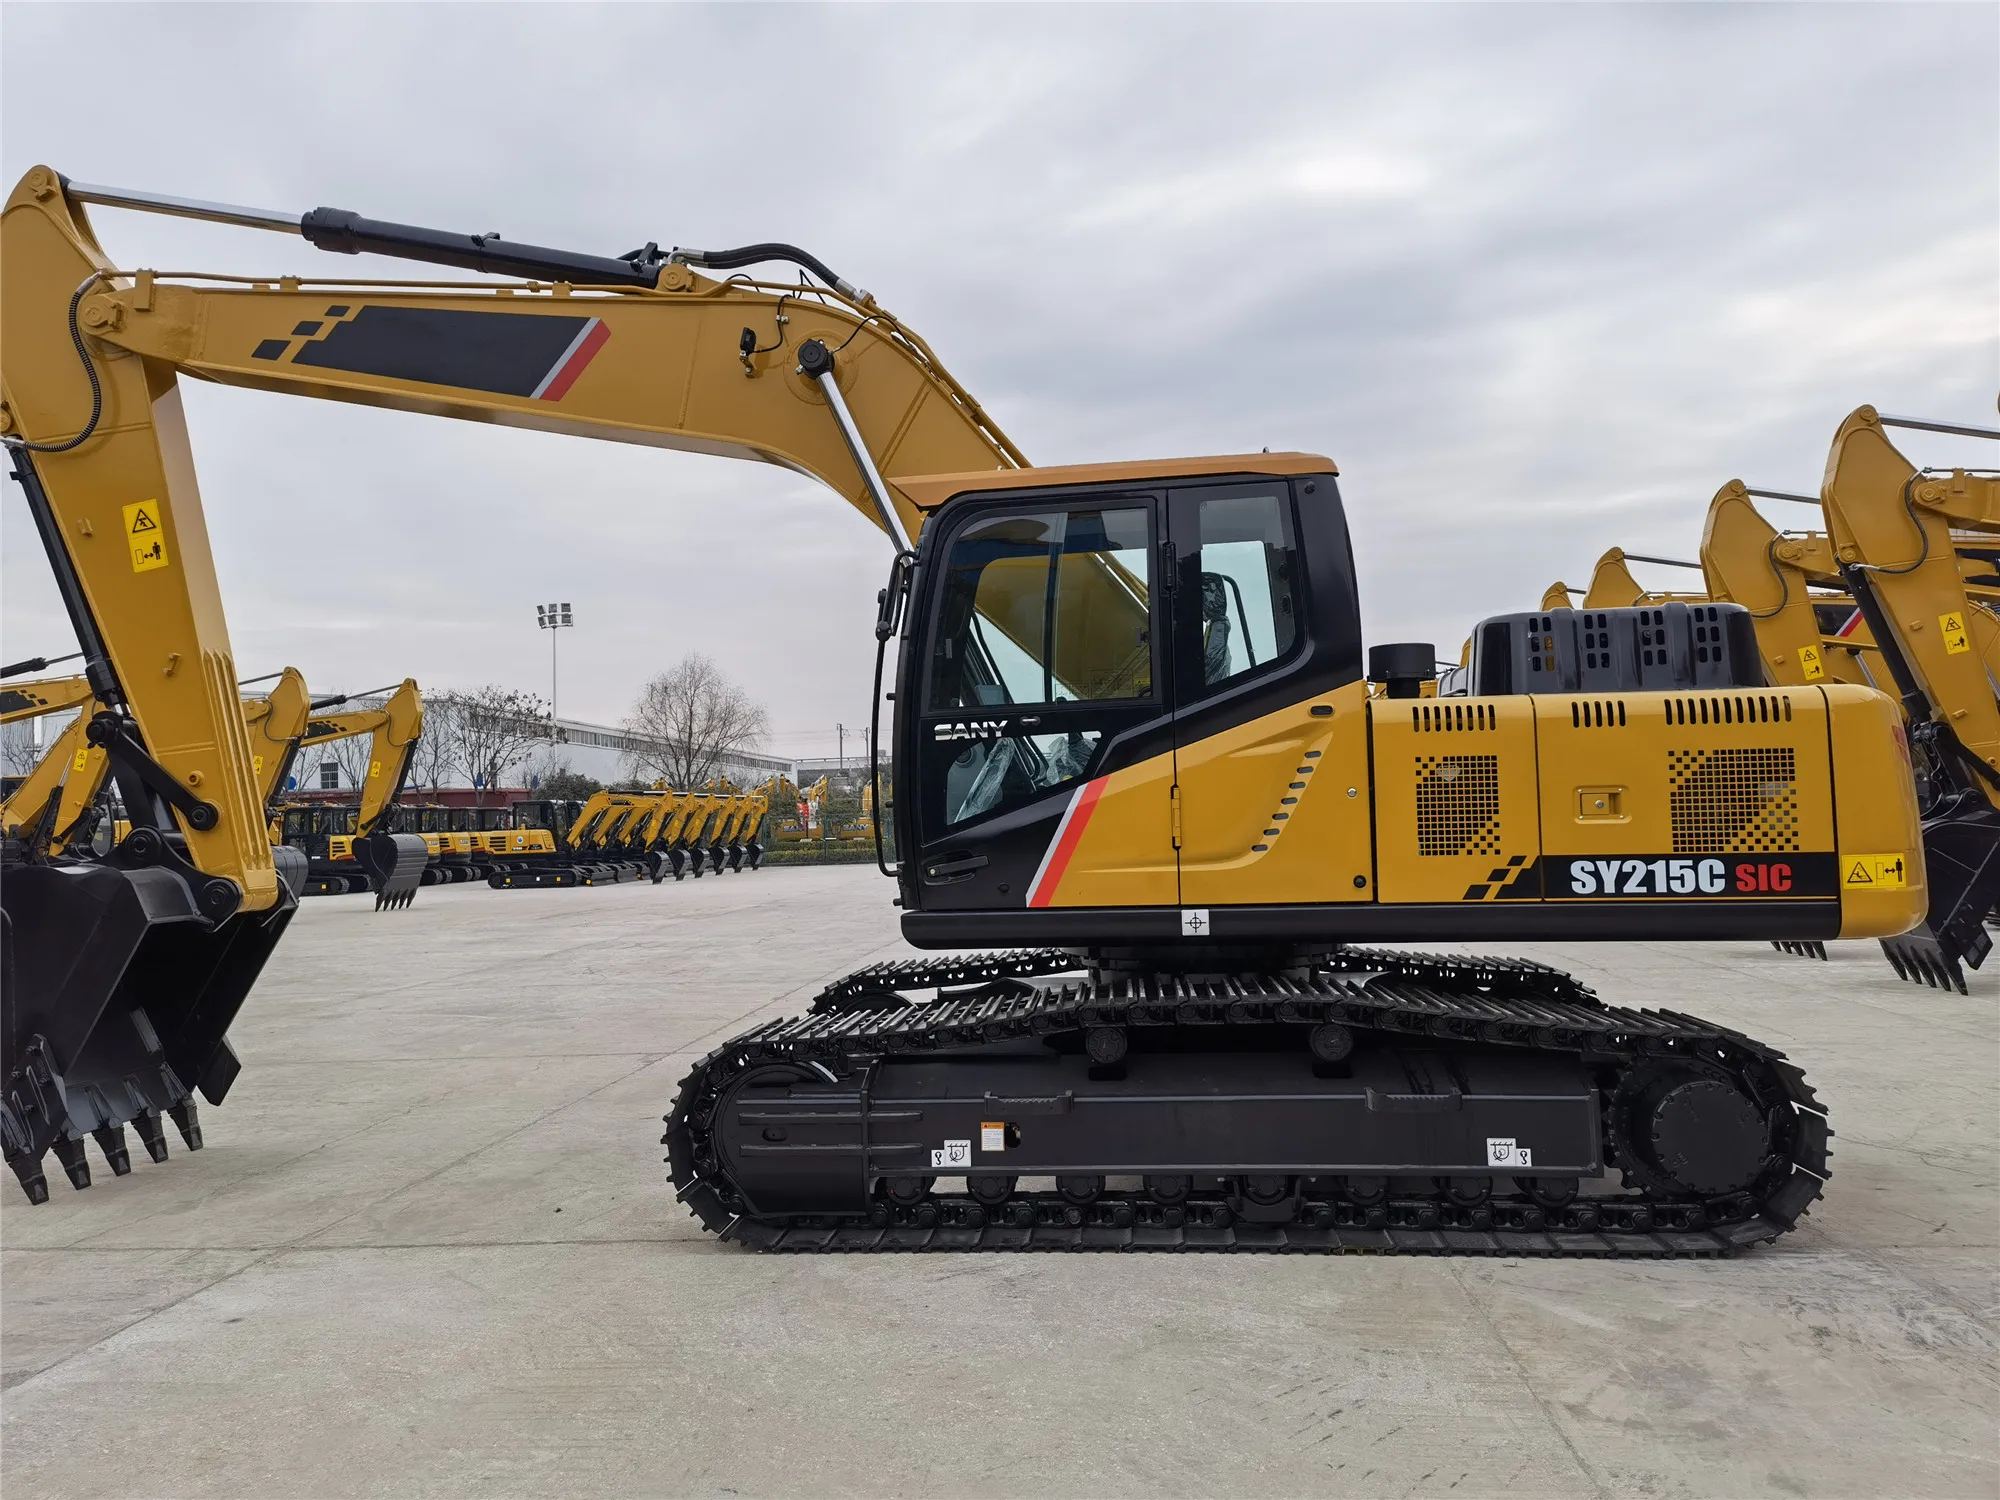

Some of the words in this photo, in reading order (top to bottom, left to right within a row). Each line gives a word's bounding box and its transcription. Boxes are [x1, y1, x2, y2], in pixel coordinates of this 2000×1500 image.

[934, 720, 1008, 741] SANY
[843, 824, 869, 832] SANY
[1571, 859, 1726, 894] SY215C
[1736, 863, 1792, 892] SIC
